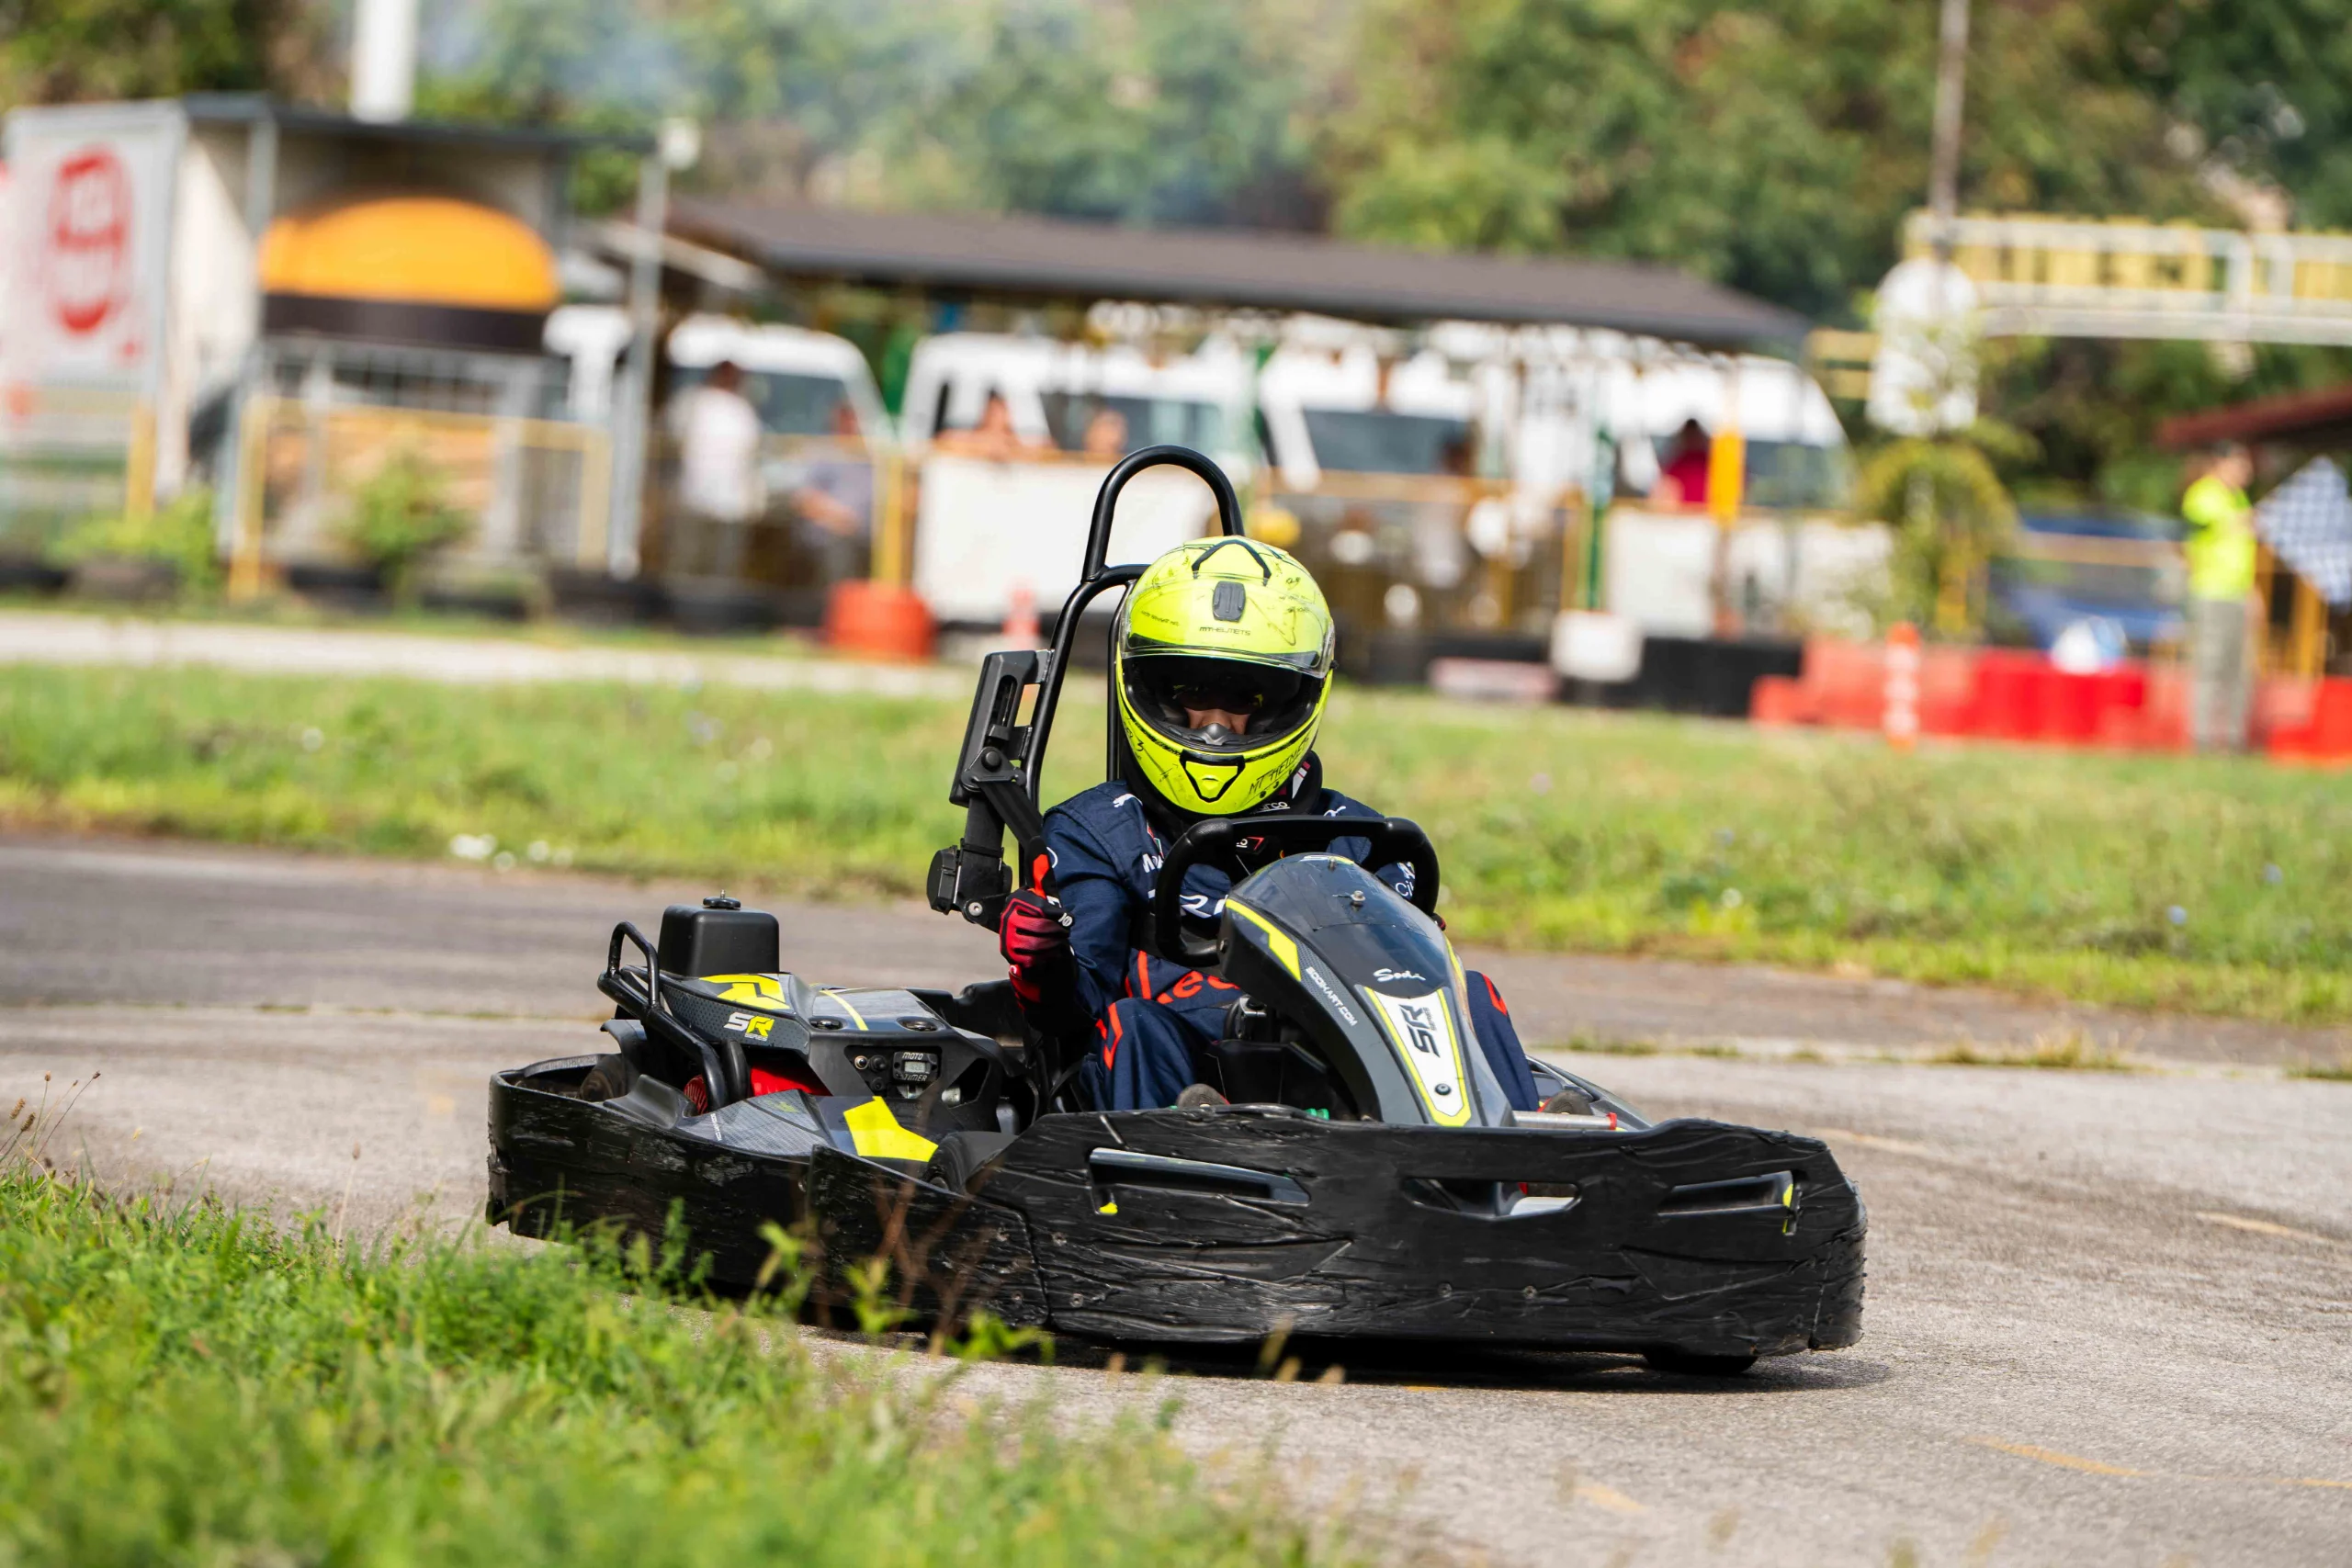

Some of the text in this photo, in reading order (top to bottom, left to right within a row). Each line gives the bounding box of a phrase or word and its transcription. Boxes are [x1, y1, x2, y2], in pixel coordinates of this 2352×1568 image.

[723, 1011, 775, 1037] SR
[1397, 1003, 1441, 1058] SR
[901, 1052, 923, 1060] MOTO
[903, 1073, 927, 1082] TIMER
